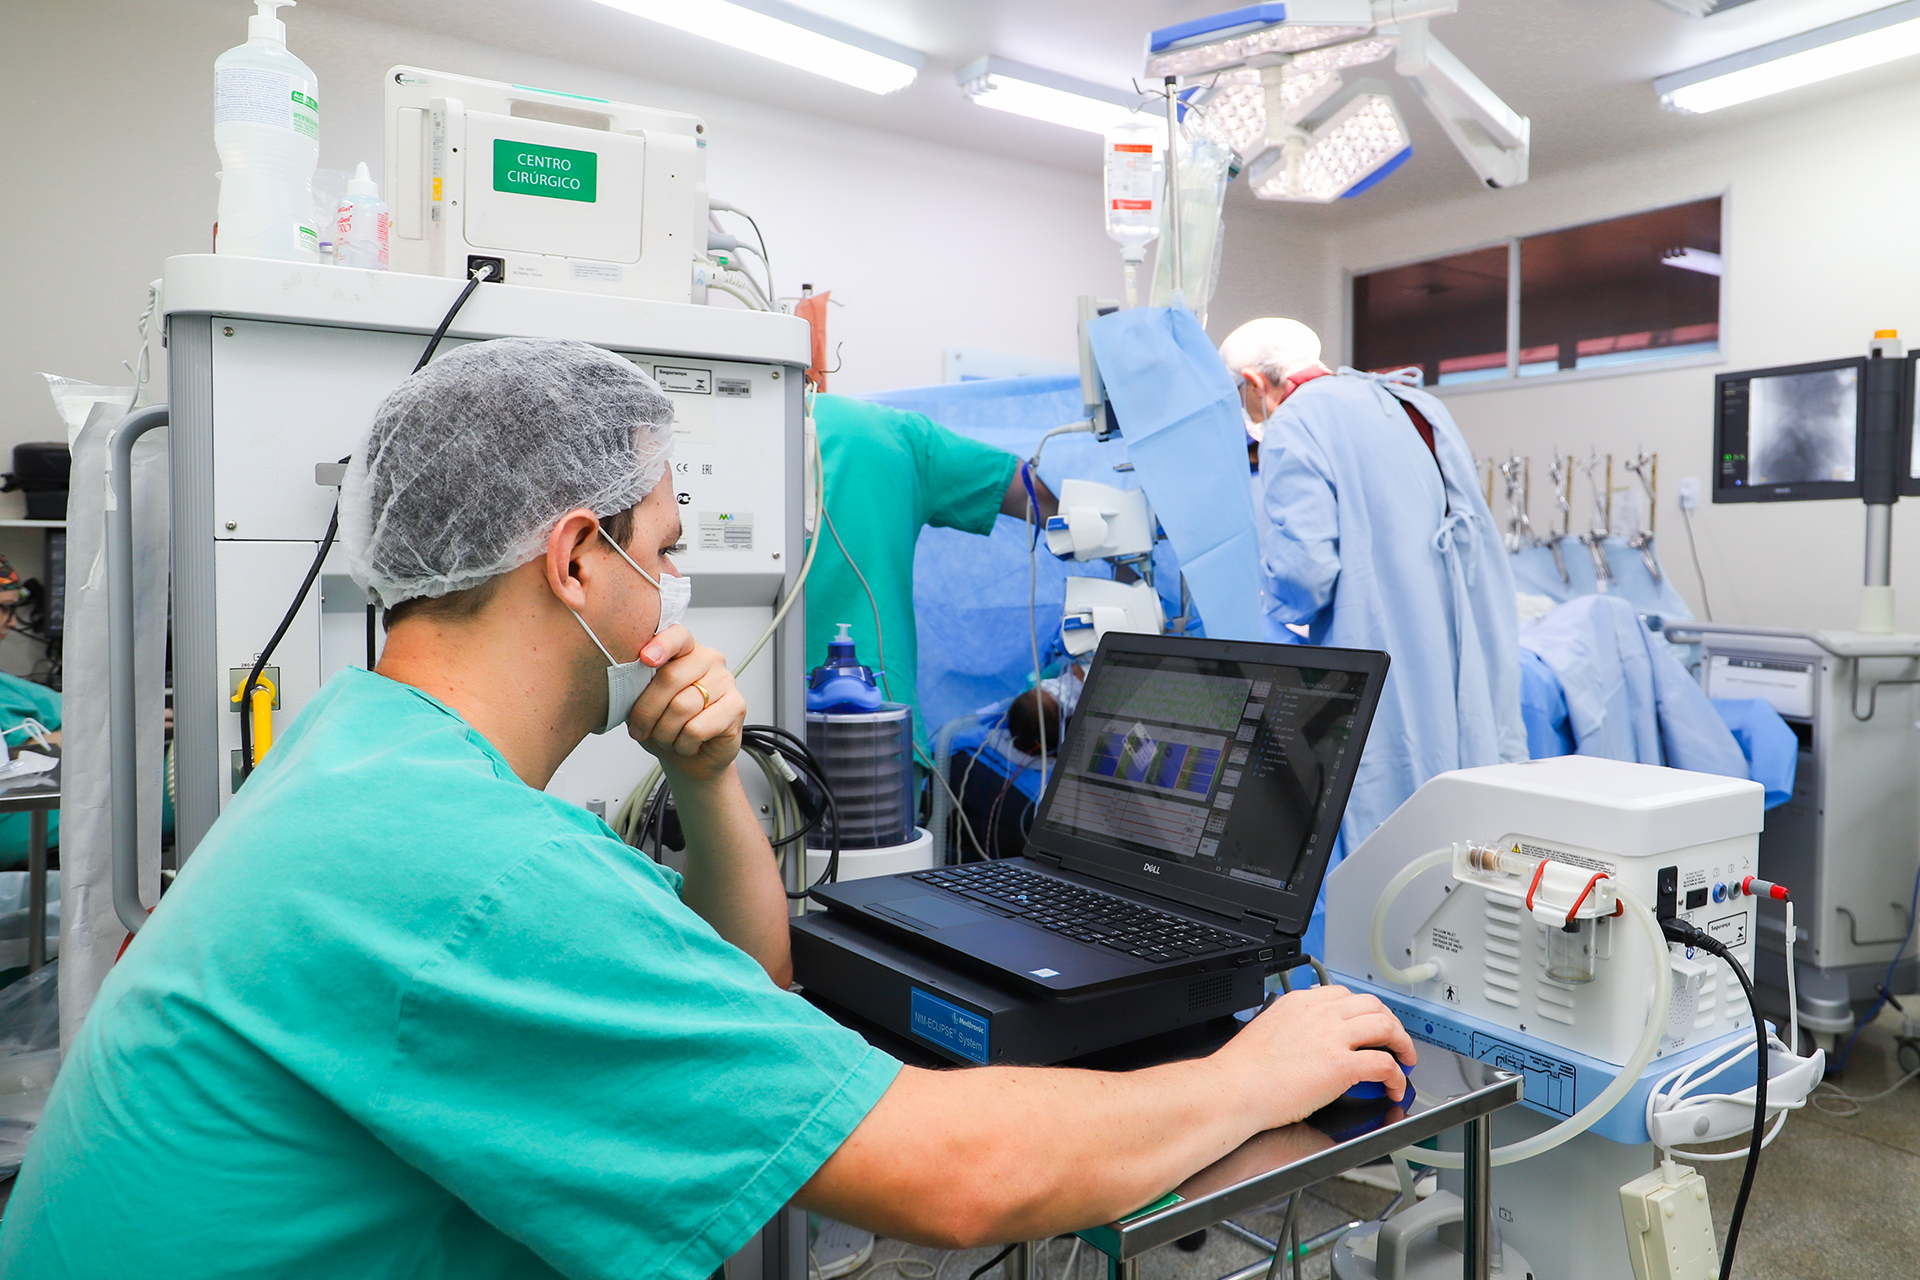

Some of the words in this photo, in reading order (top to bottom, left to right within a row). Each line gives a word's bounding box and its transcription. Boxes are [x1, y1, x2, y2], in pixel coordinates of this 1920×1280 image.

[517, 153, 571, 171] CENTRO
[507, 171, 580, 190] CIRÚRGICO
[1143, 862, 1160, 875] DELL
[1711, 922, 1730, 931] Segurança
[959, 1018, 984, 1034] Medtronic
[958, 1032, 982, 1051] System
